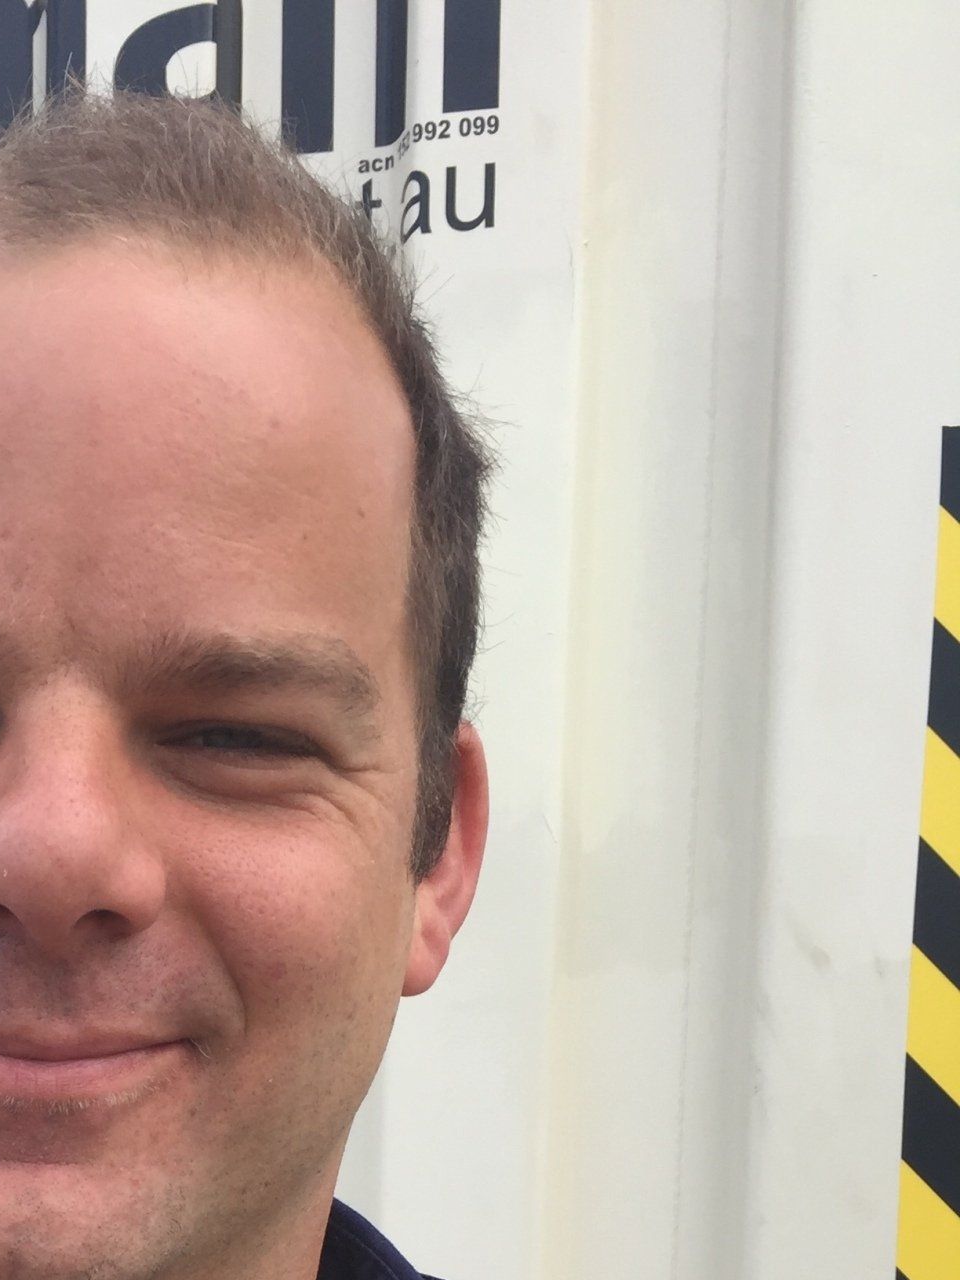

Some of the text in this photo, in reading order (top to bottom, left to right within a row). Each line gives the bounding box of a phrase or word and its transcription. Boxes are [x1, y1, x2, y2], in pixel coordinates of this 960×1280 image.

[358, 155, 395, 174] acn
[412, 119, 451, 143] 992
[459, 115, 500, 138] 099
